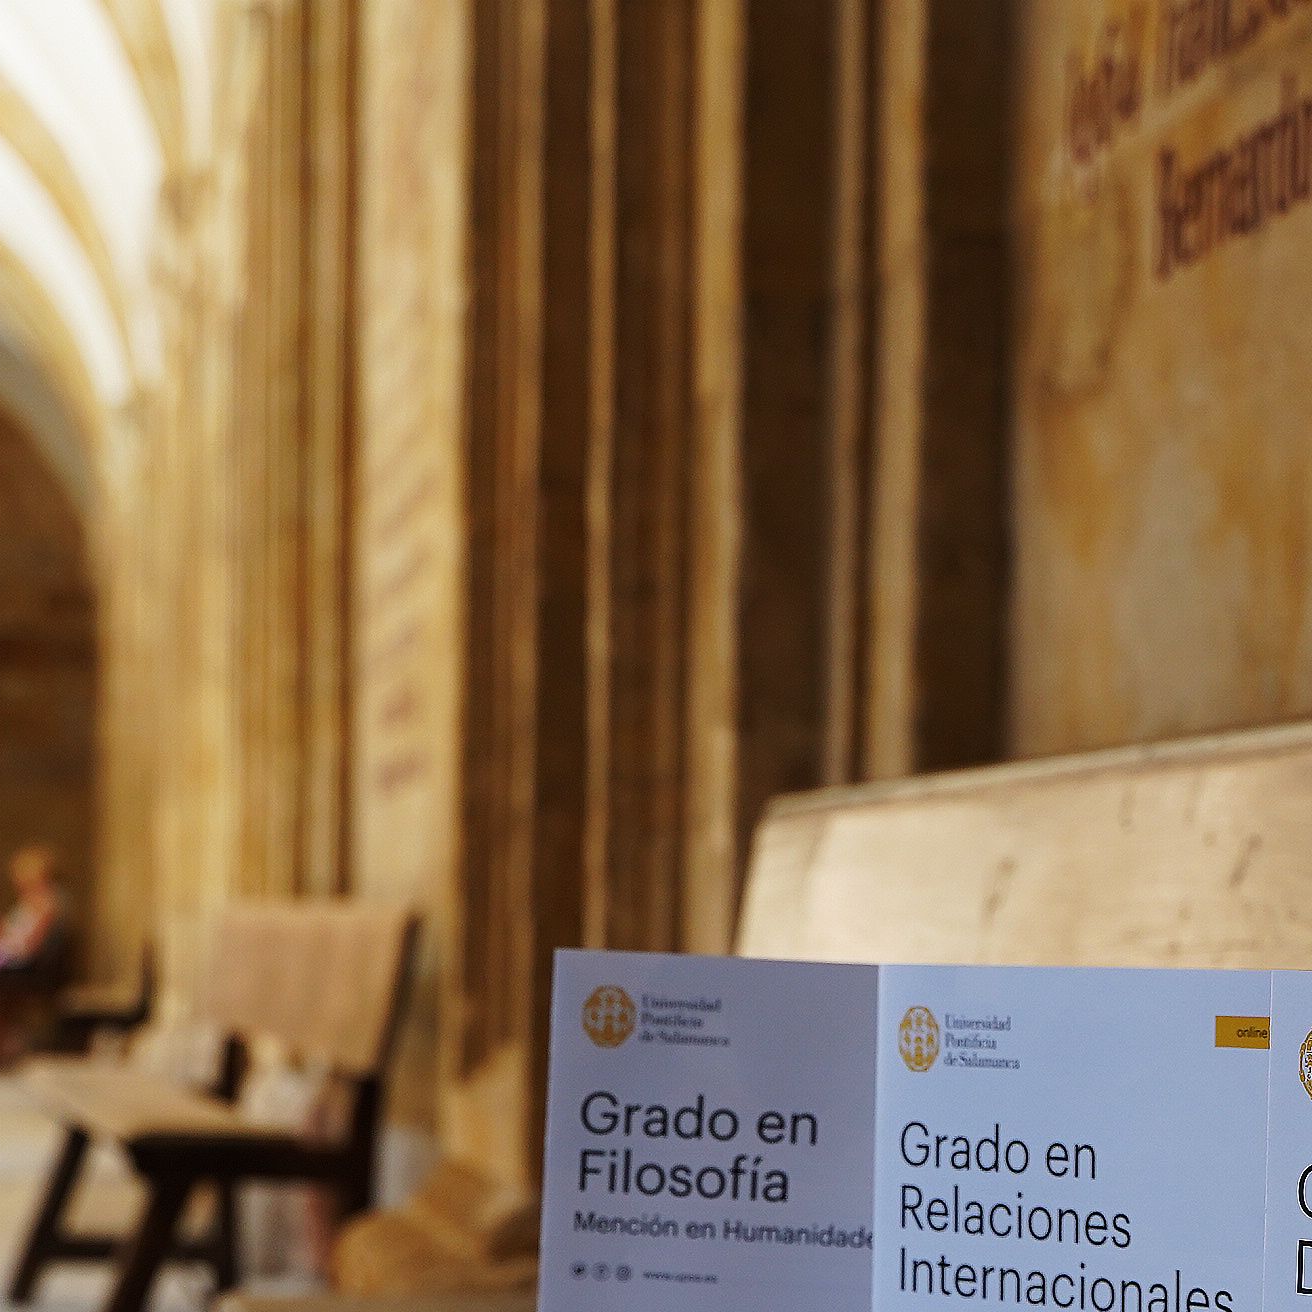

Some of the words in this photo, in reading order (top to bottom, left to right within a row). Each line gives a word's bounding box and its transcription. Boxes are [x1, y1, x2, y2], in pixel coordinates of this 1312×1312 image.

[580, 1091, 739, 1141] Grado
[756, 1111, 818, 1146] en
[579, 1148, 789, 1202] Filosofía
[900, 1121, 1029, 1174] Grado
[1046, 1142, 1096, 1179] en
[573, 1210, 679, 1238] Mención
[686, 1222, 716, 1240] en
[900, 1185, 1132, 1248] Relaciones
